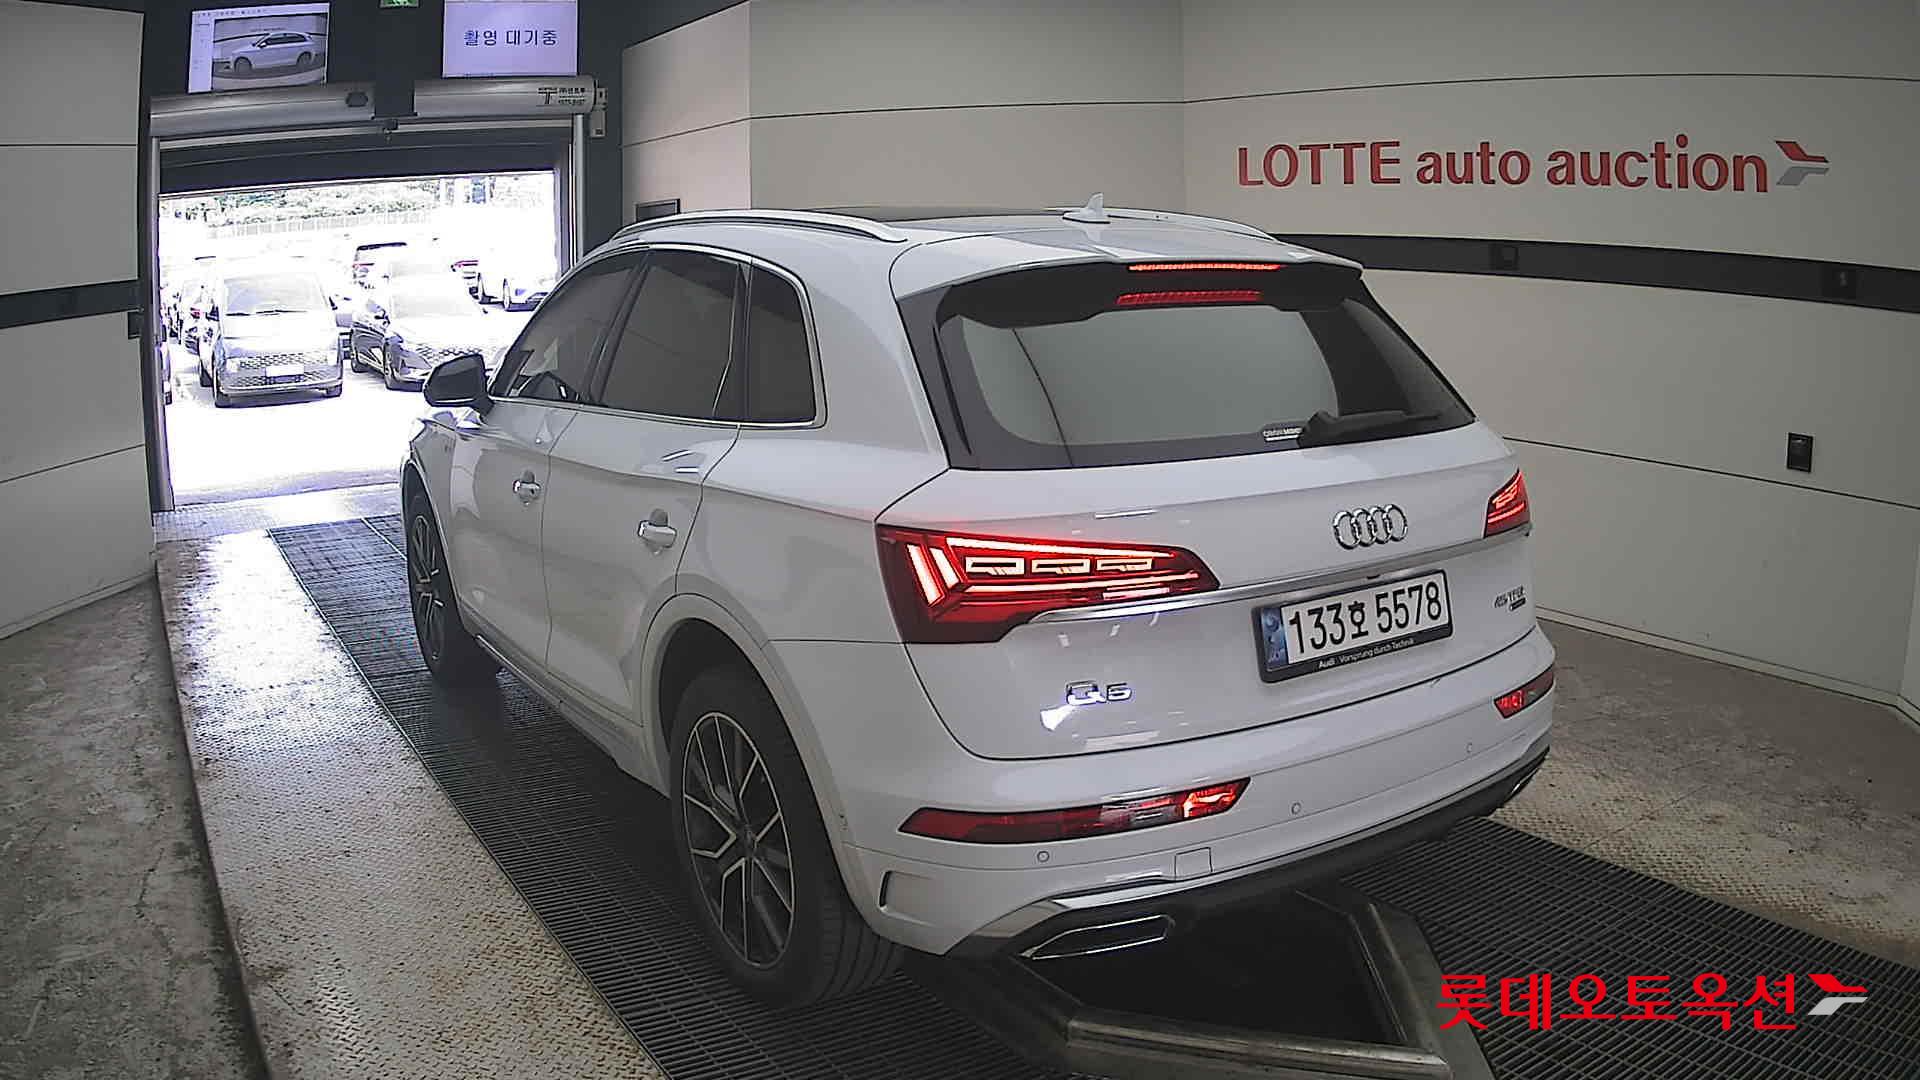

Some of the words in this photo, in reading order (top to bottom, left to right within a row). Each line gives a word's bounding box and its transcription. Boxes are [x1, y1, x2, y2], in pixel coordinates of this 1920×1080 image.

[505, 29, 558, 46] 대기중
[1238, 140, 1401, 188] LOTTE
[1416, 141, 1531, 185] auto
[1546, 134, 1768, 193] auction
[1289, 600, 1369, 654] 133호
[1375, 581, 1442, 633] 5578
[1319, 658, 1336, 669] Audi
